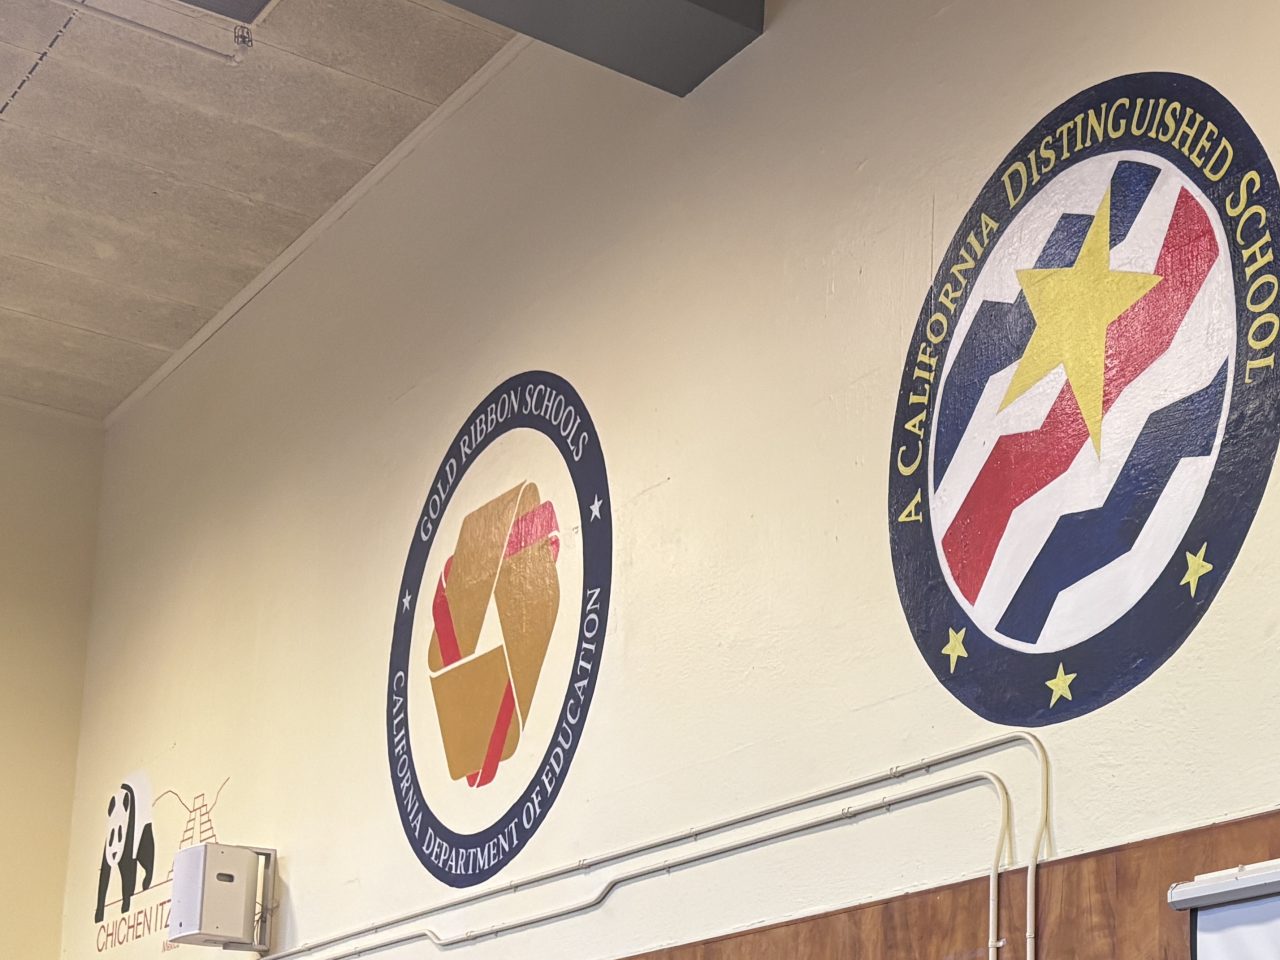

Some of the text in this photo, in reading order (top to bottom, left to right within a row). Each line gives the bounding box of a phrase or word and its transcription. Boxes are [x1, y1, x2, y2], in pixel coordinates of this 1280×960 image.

[897, 97, 1280, 523] A CALIFORNIA DISTINGUISHED SCHOOL
[420, 384, 589, 542] GOLD RIBBON SCHOOLS
[392, 587, 601, 876] CALIFORNIA DEPARTMENT OF EDUCATION
[97, 906, 153, 953] CHICHEN
